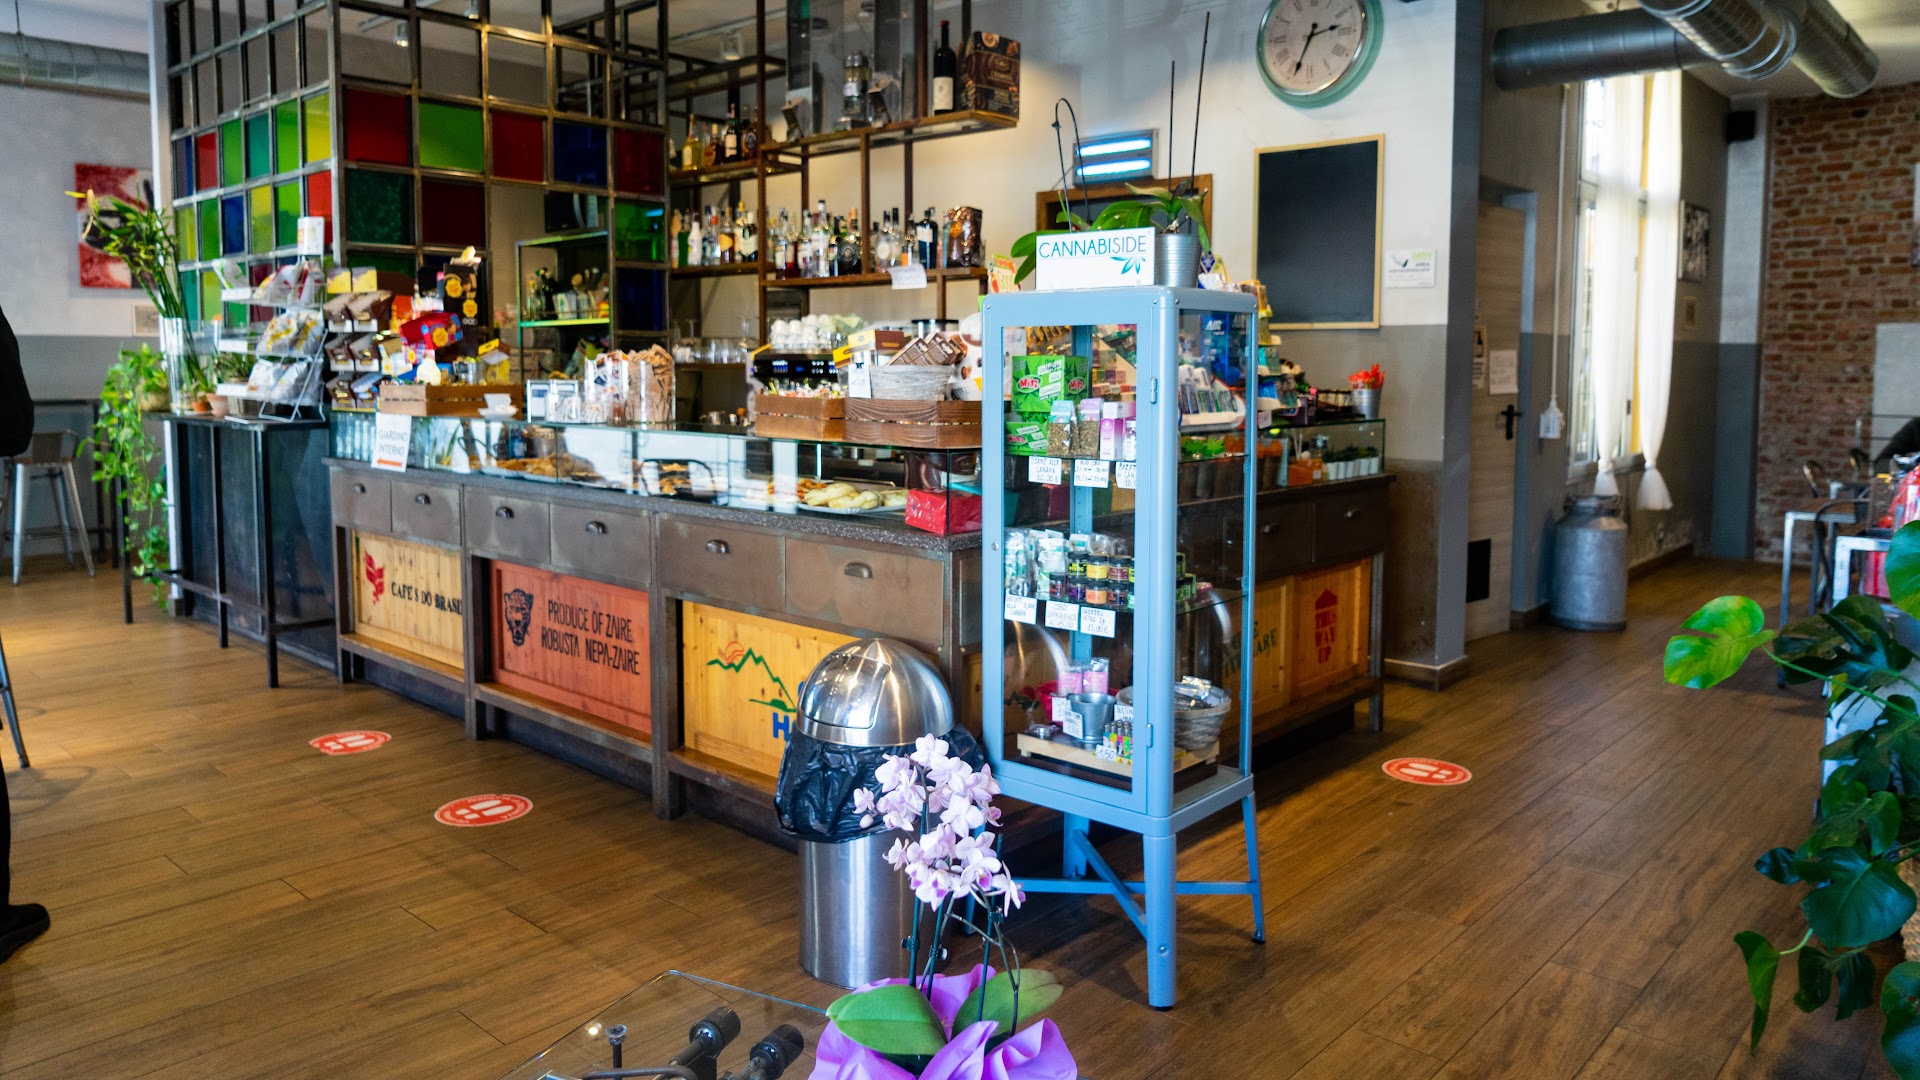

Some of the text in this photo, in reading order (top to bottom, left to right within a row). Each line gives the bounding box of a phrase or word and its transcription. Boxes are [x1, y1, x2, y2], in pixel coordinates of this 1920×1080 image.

[1039, 235, 1146, 258] CANNABISIDE
[378, 429, 408, 442] GIARDINO
[377, 443, 405, 456] INTERNO
[421, 590, 433, 606] DO
[547, 599, 633, 643] PRODUCE OF ZAIRE
[541, 625, 641, 676] ROBUSTA NEPA-ZAIRE
